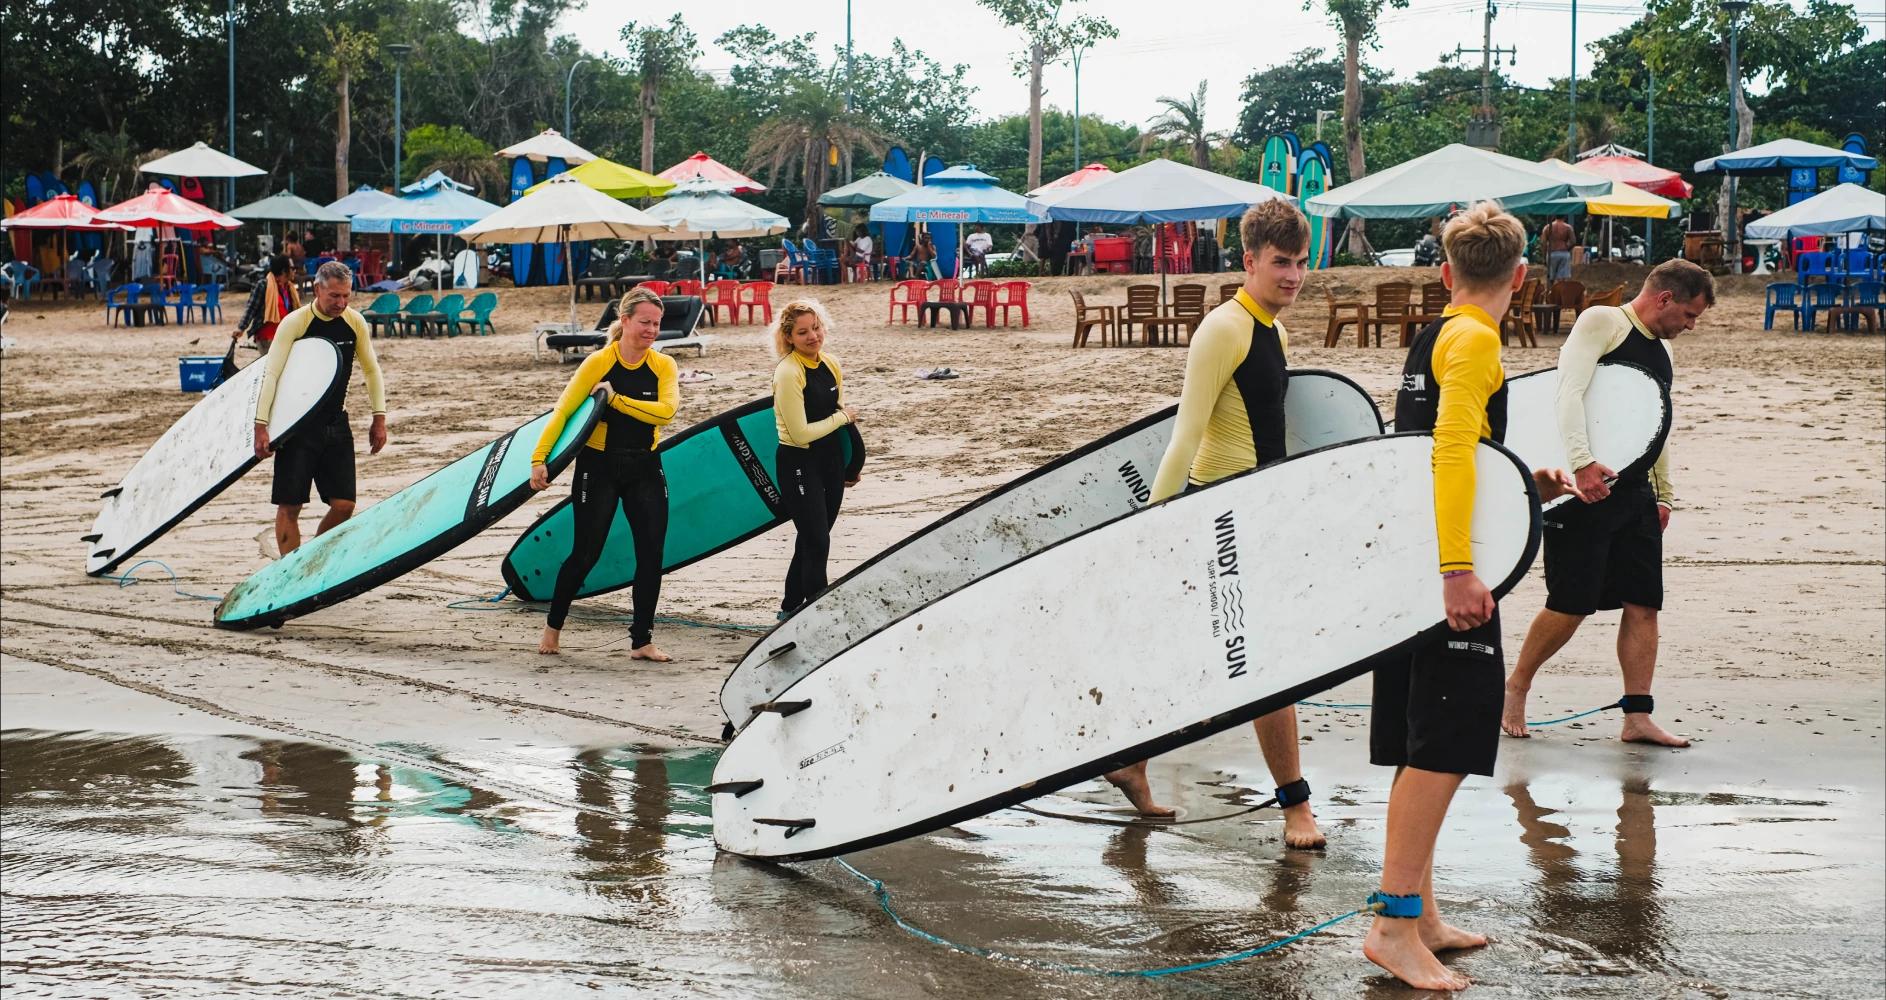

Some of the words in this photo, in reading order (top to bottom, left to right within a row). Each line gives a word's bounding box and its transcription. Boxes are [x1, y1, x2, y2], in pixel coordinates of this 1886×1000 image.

[413, 220, 453, 231] Minerale
[915, 210, 927, 220] Le
[929, 210, 970, 221] Minerale
[1118, 460, 1151, 503] WIND
[476, 485, 490, 507] SUN
[1127, 498, 1139, 510] SUR
[1214, 509, 1239, 577] WINDY
[1207, 559, 1216, 580] SURF
[1209, 581, 1219, 612] SCHOOL
[1212, 619, 1221, 638] BALI
[1447, 640, 1469, 650] WINDY
[1225, 635, 1247, 679] SUN
[799, 757, 815, 769] Size
